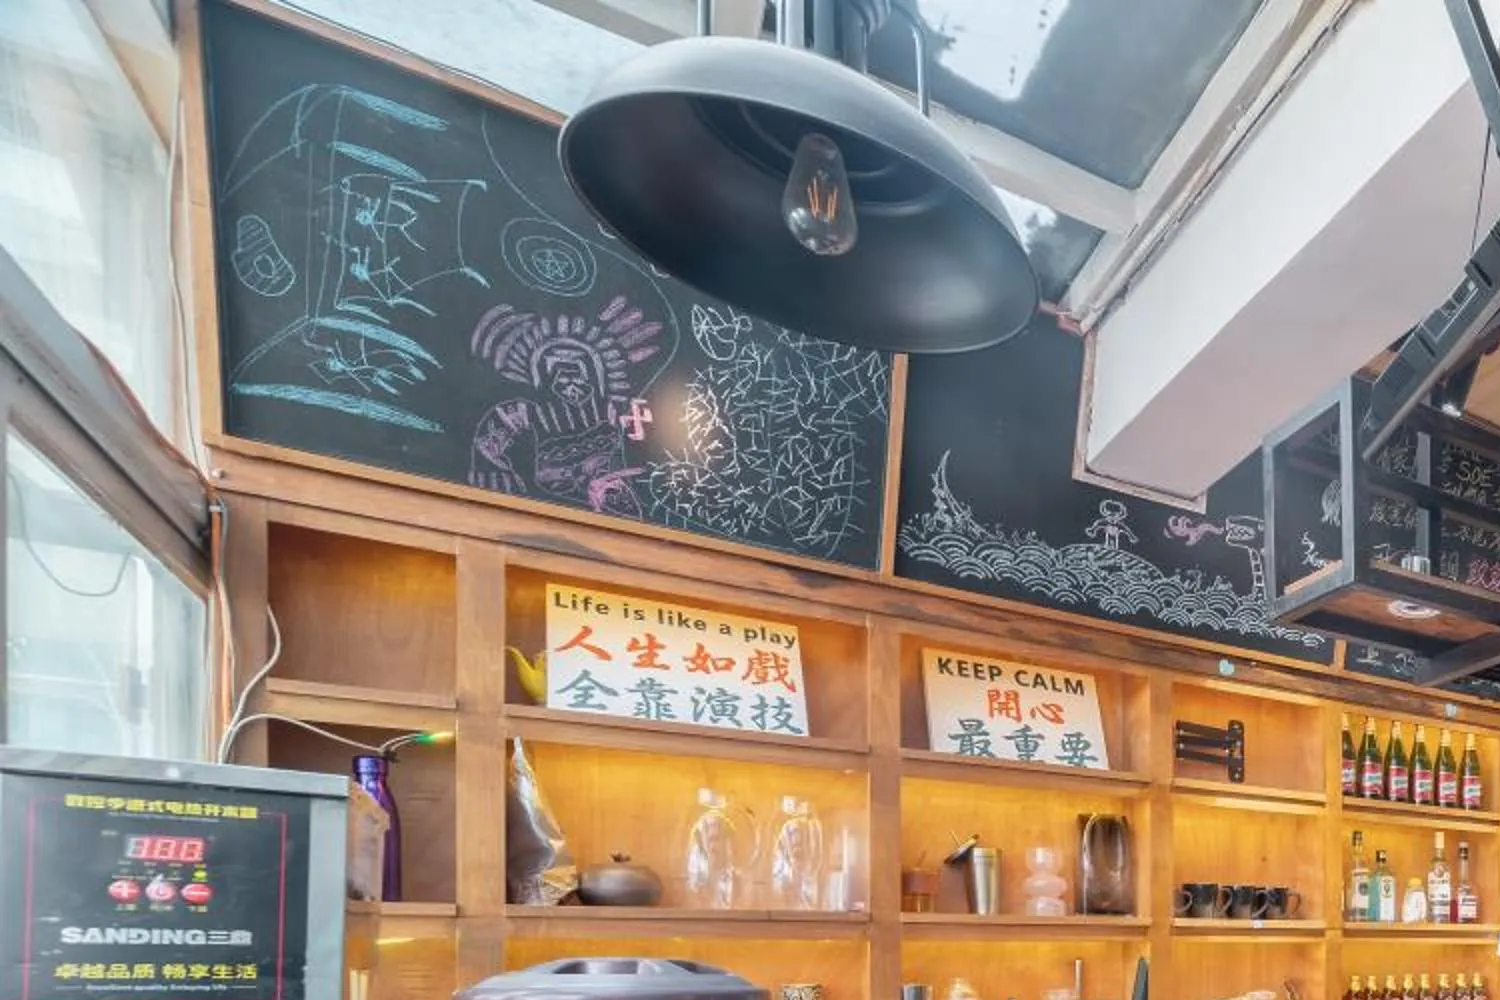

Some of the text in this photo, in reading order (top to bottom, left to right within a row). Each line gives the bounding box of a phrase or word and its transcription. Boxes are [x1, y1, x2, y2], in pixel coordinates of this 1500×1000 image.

[553, 591, 797, 651] Life is like a play
[556, 669, 804, 734] 全靠演技
[938, 657, 1085, 696] KEEP CALM
[986, 689, 1066, 725] 開心
[948, 718, 1099, 769] 最重要
